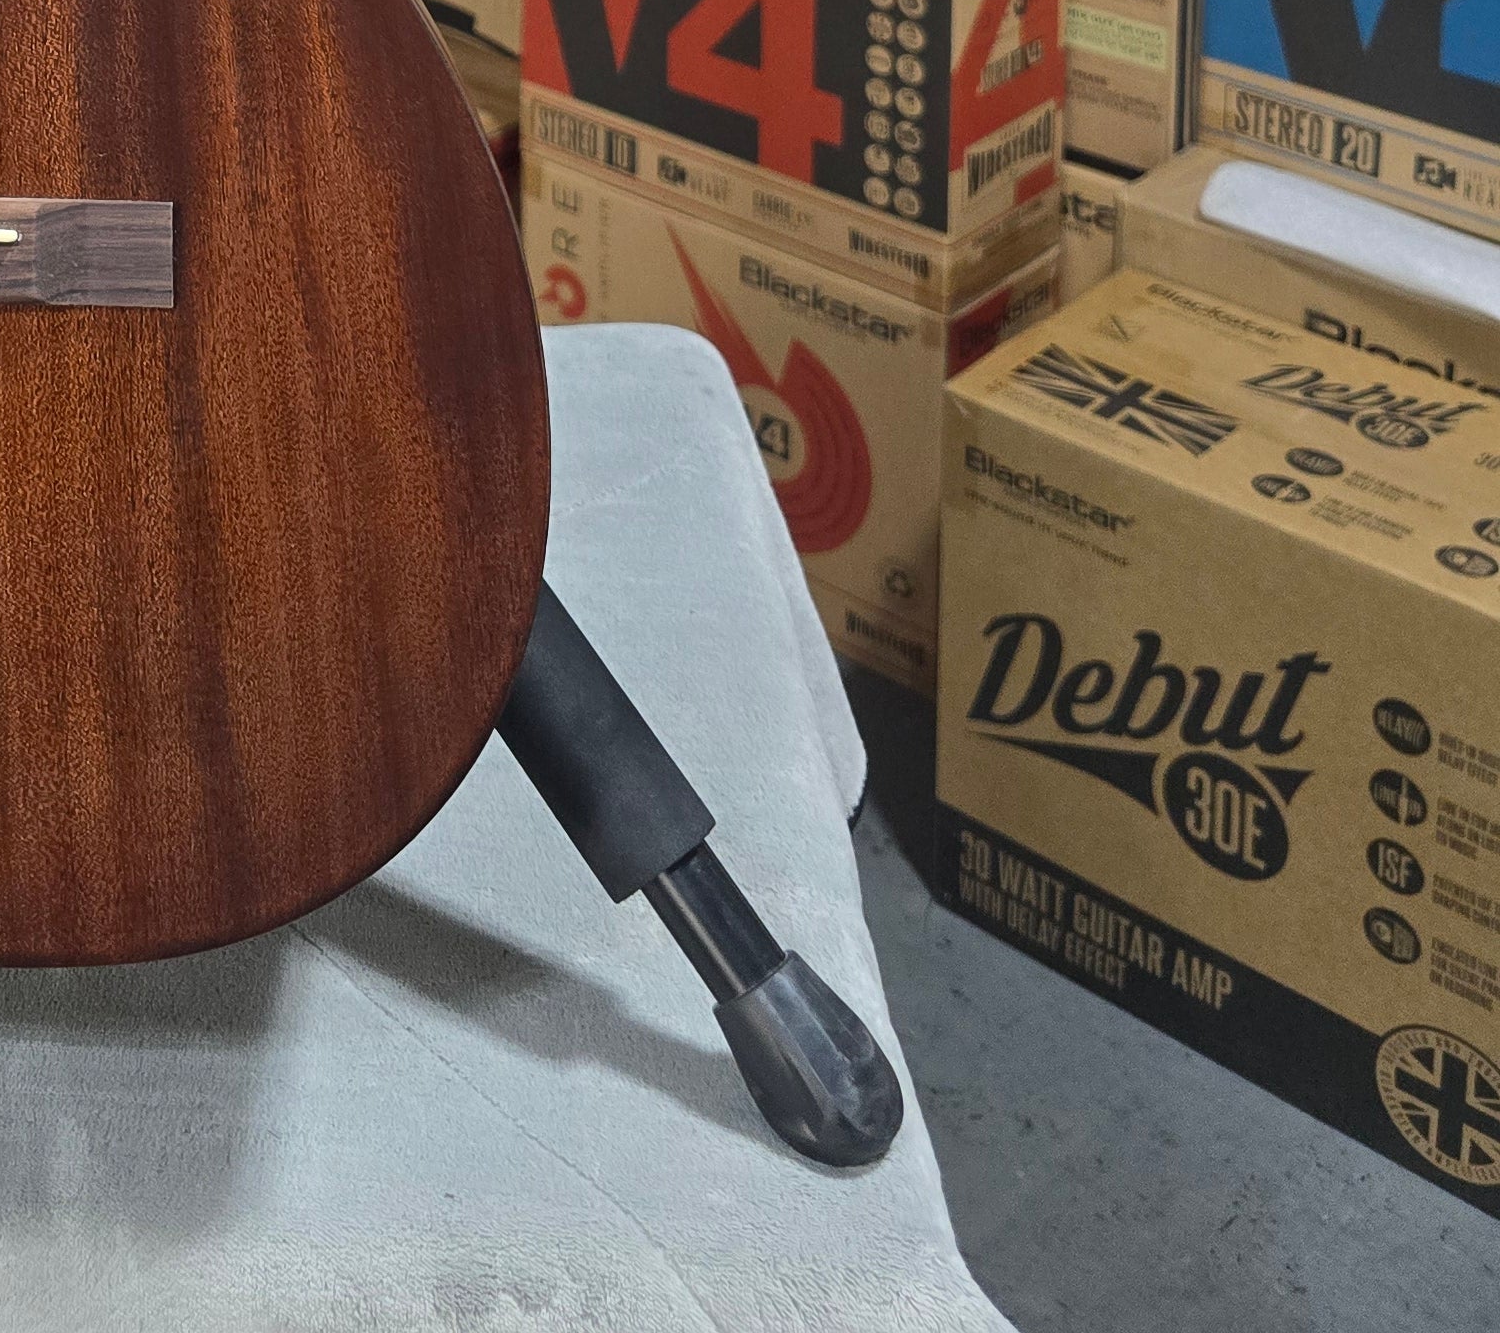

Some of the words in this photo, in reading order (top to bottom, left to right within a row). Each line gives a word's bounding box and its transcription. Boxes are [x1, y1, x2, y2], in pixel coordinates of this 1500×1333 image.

[539, 108, 597, 159] STEREO
[1234, 90, 1323, 158] STEREO
[1340, 124, 1374, 174] 20
[738, 253, 913, 344] Blackstar
[1240, 364, 1488, 433] Debut
[965, 444, 1131, 531] Blackstar
[965, 612, 1332, 755] Debut
[1184, 767, 1268, 873] 30E
[1378, 842, 1411, 889] ISF
[959, 830, 991, 881] 30
[998, 849, 1066, 922] WATT
[1073, 892, 1164, 979] GUITAR
[1172, 948, 1233, 1011] AMP
[1007, 899, 1061, 953] DELAY
[1064, 932, 1127, 991] EFFECT
